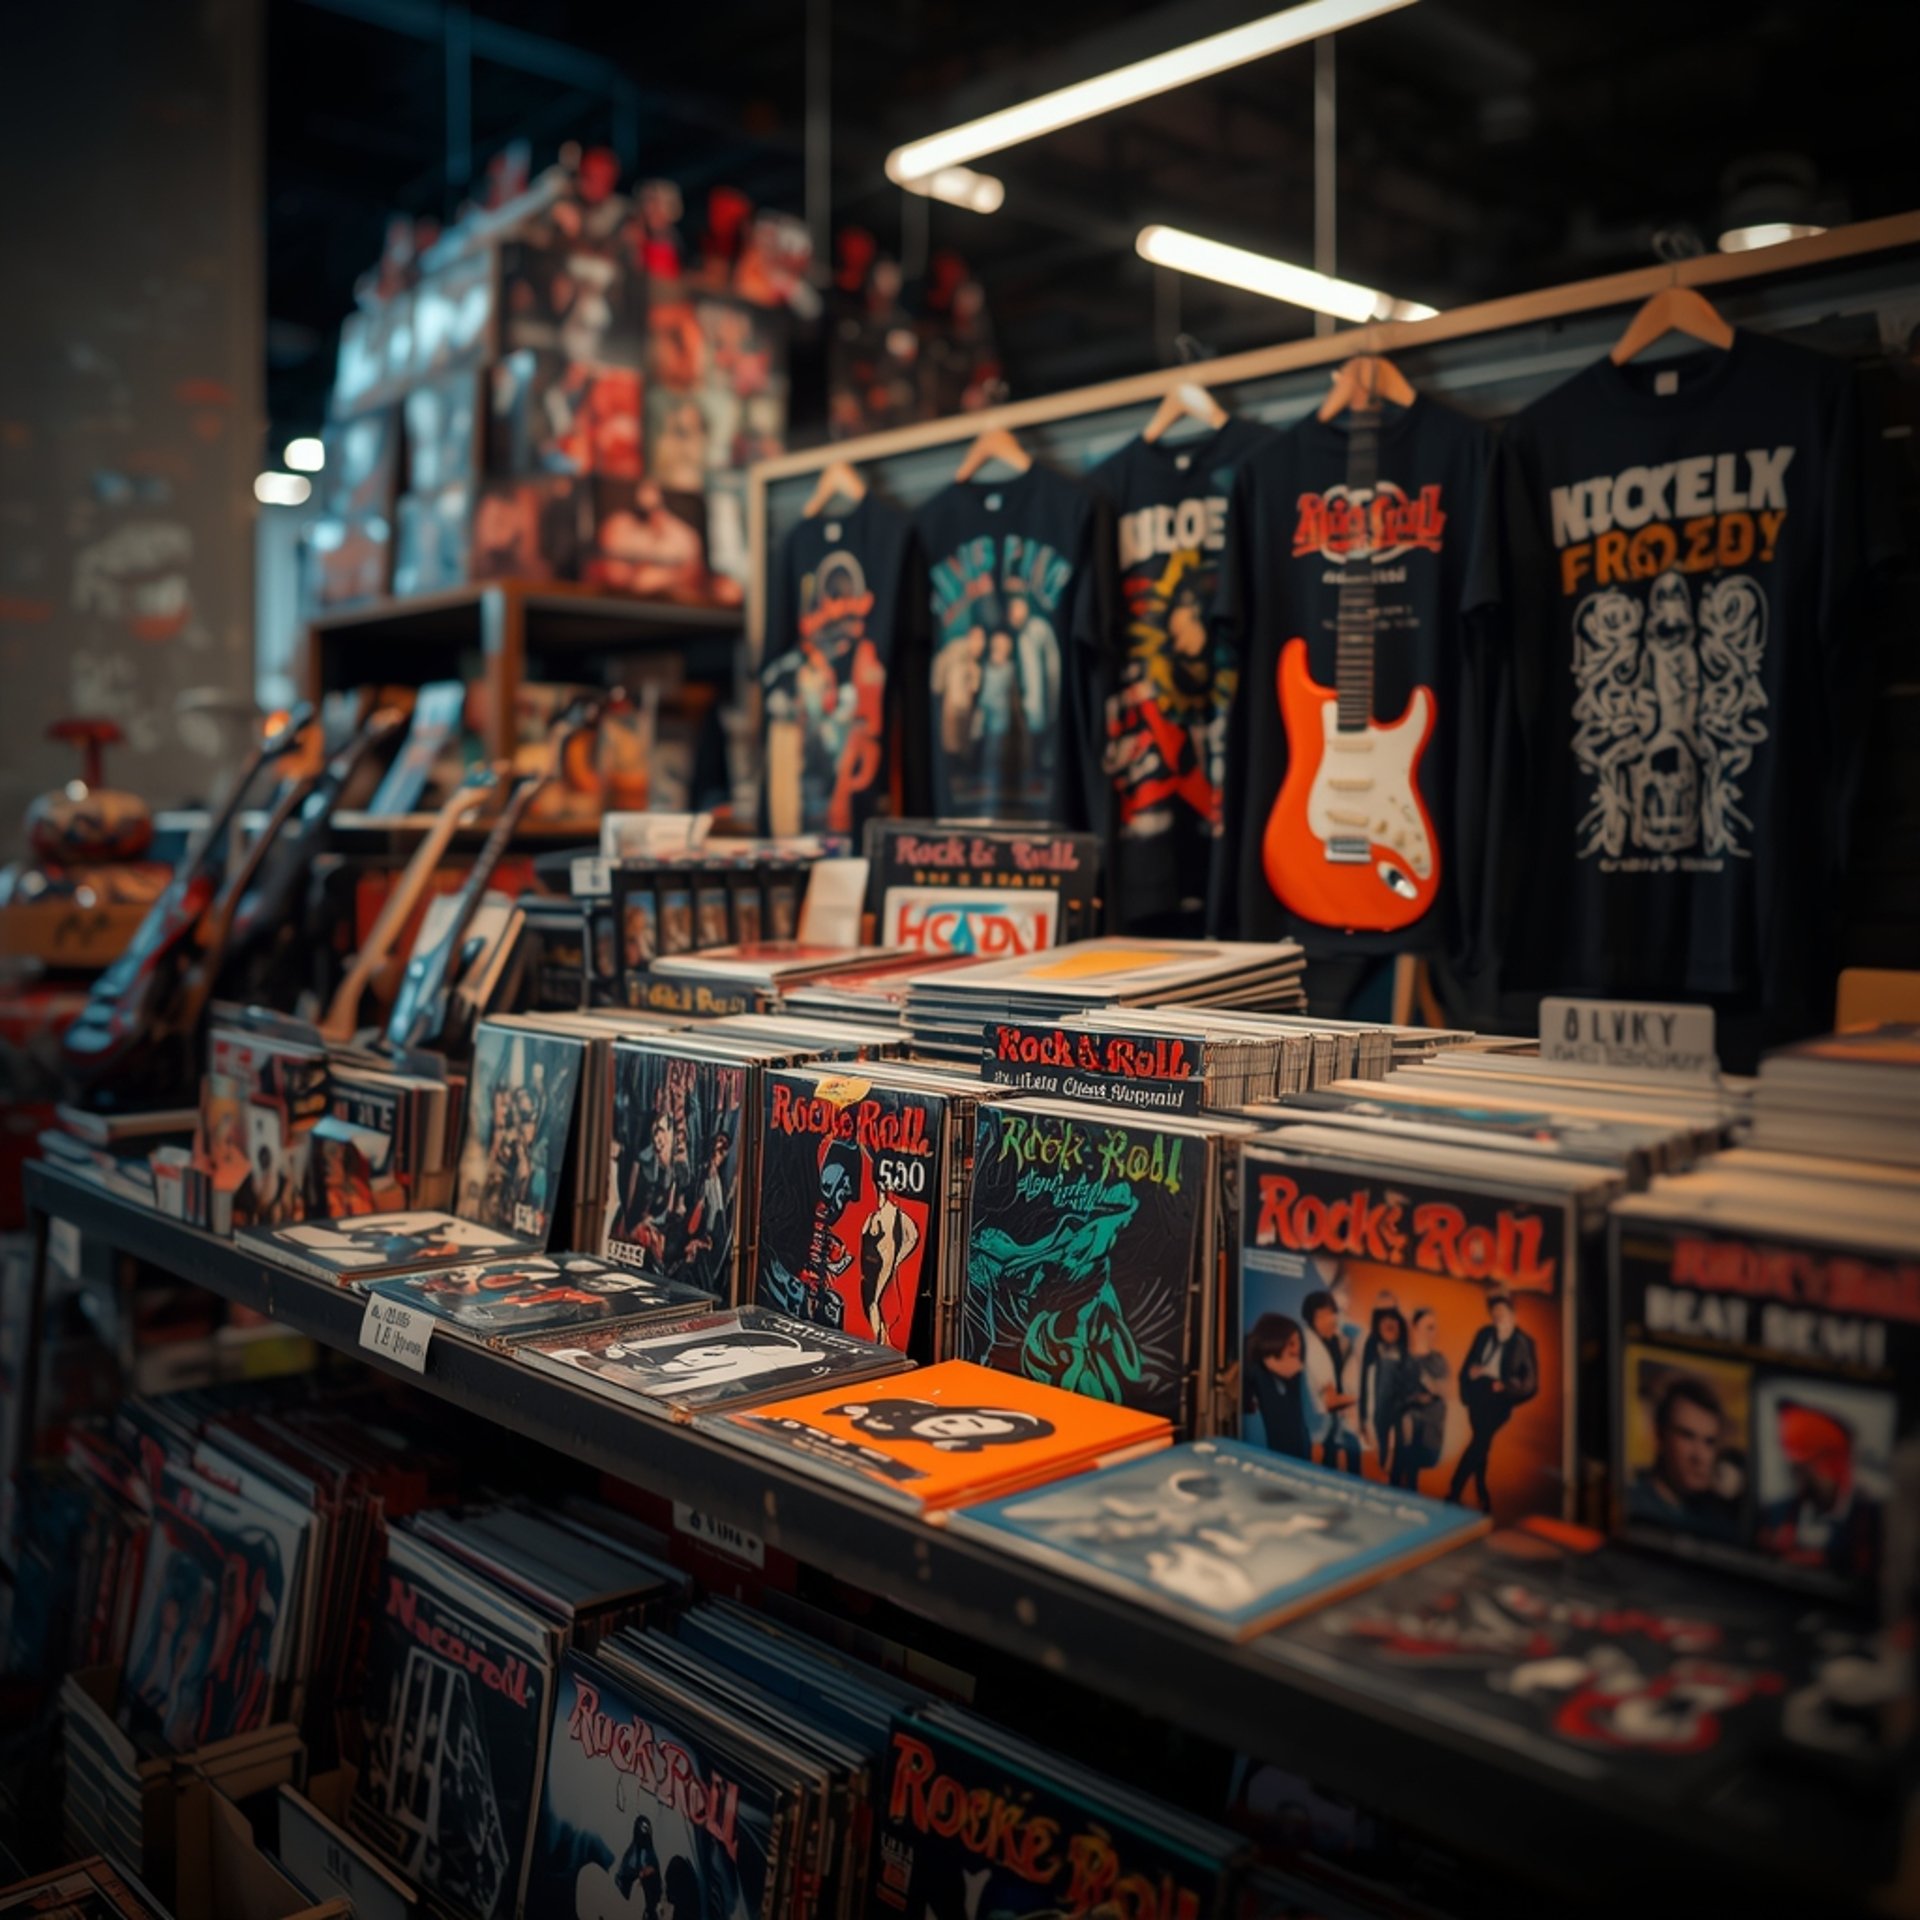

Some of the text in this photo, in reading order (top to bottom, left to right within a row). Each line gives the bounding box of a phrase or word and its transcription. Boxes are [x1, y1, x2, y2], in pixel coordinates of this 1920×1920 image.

[996, 1025, 1076, 1069] Rock
[1106, 1038, 1192, 1081] Roll
[1256, 1174, 1389, 1262] Rock
[1413, 1203, 1556, 1293] Roll
